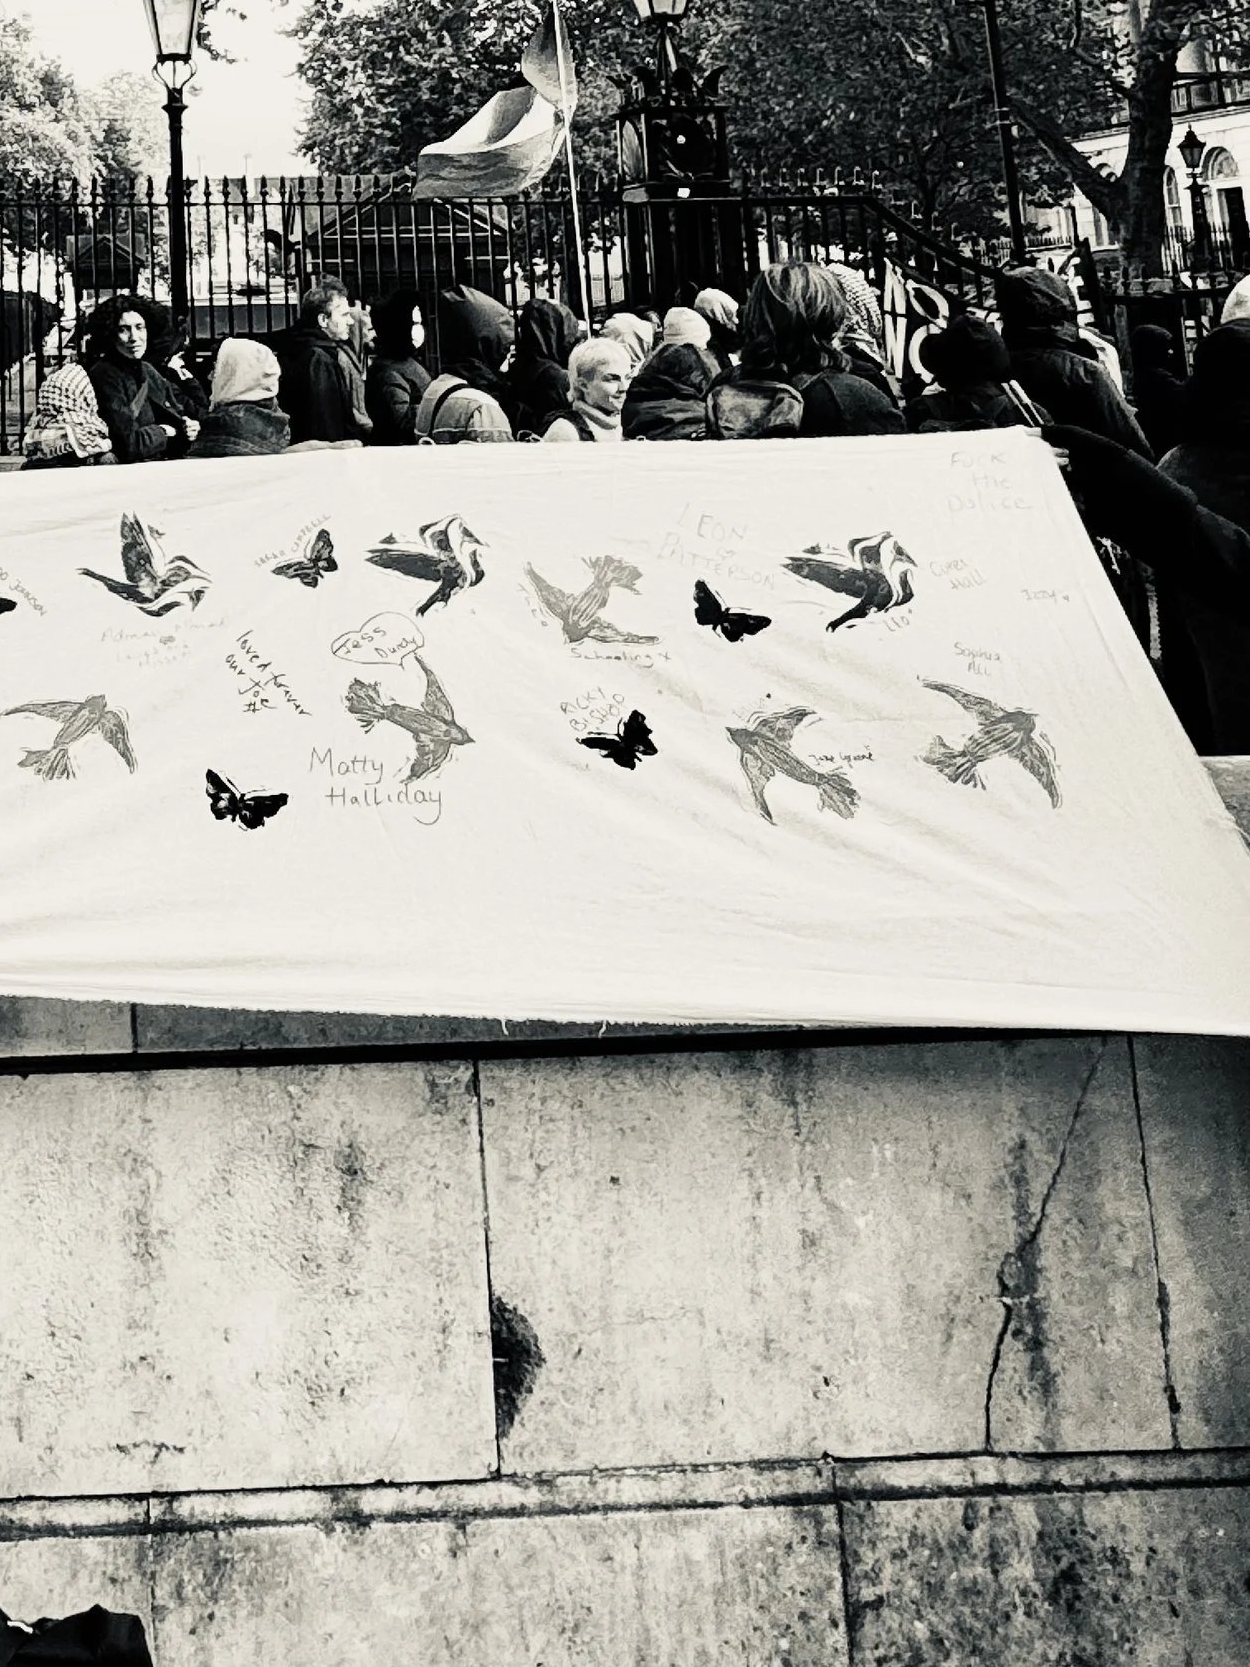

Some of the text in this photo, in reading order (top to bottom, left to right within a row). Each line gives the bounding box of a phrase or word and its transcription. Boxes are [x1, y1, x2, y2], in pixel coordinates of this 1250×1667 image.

[676, 502, 748, 542] LEON
[657, 531, 774, 590] PATTERSON
[225, 654, 278, 709] our Joe
[560, 686, 606, 715] RICKY
[309, 746, 384, 786] Matty
[325, 784, 442, 825] Halliday
